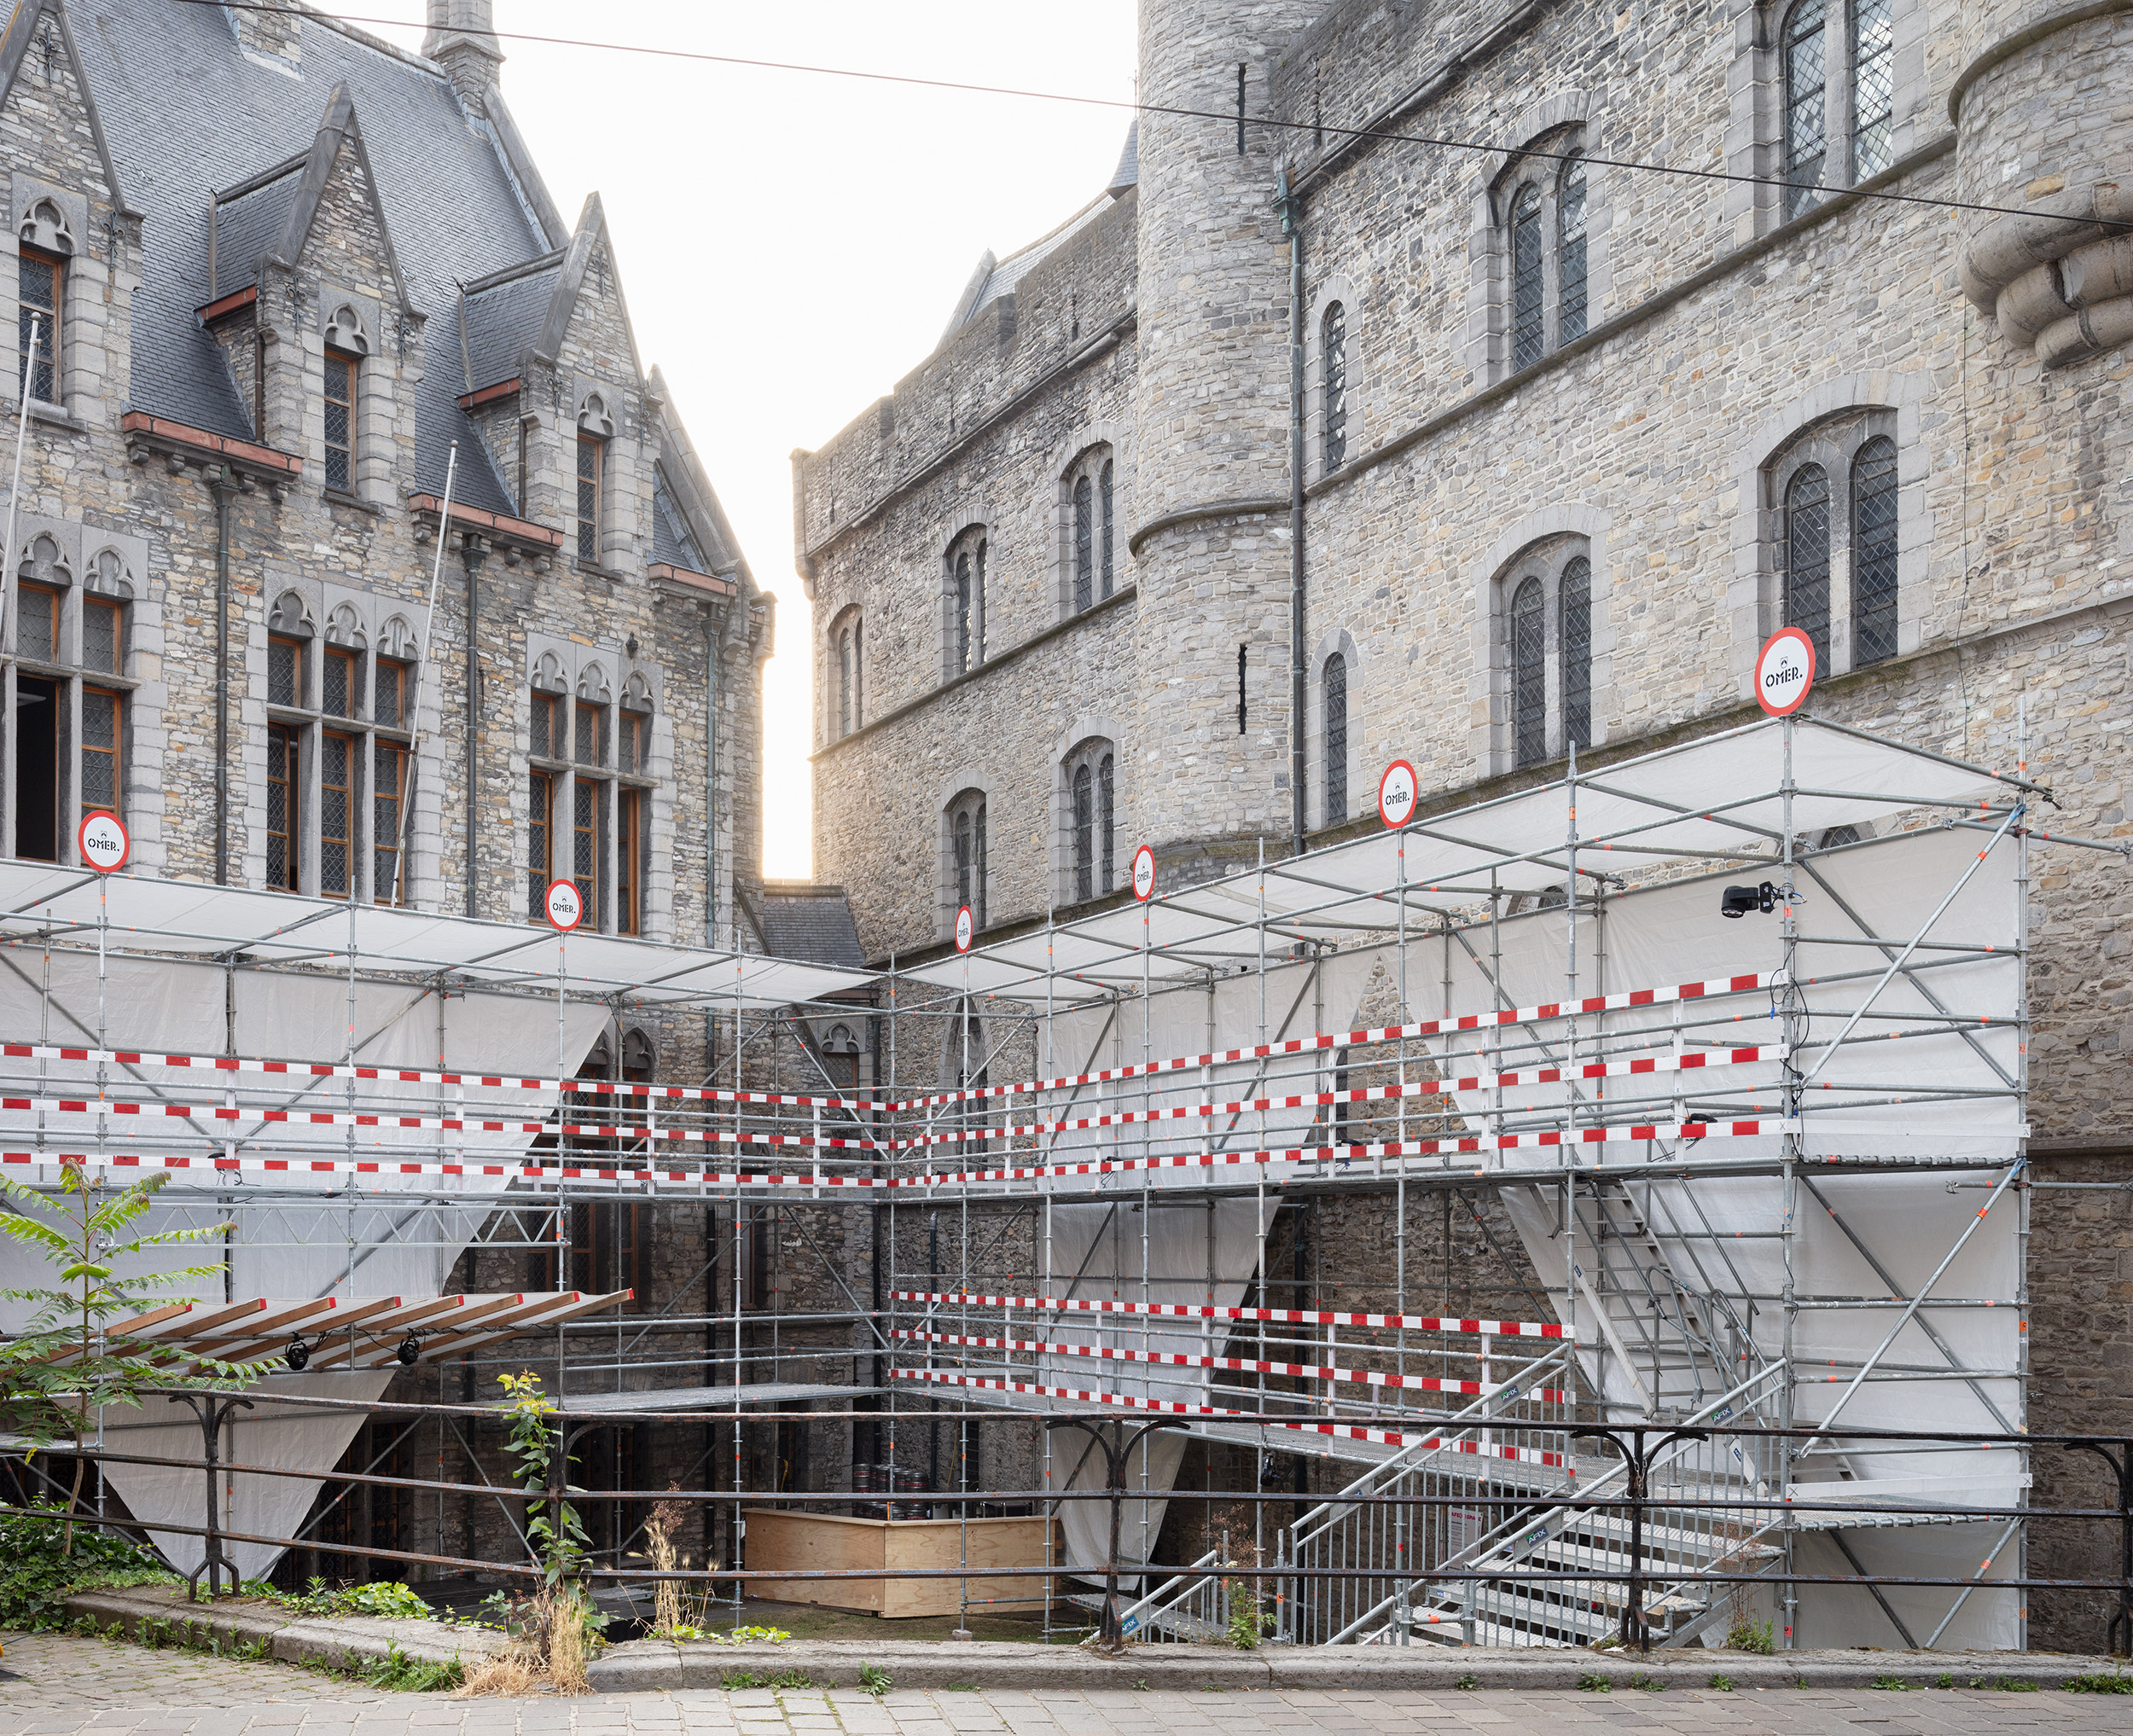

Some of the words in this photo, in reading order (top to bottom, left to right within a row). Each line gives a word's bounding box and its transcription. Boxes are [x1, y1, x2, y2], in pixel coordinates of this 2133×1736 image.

[1765, 666, 1803, 688] OMER.
[1385, 791, 1410, 806] OMER.
[88, 838, 120, 852] OMER.
[1136, 871, 1151, 883] OMER.
[552, 903, 577, 914] OMER.
[1502, 1388, 1517, 1401] AFIX
[1713, 1408, 1730, 1422] AFIX
[1528, 1529, 1546, 1544] AFIX
